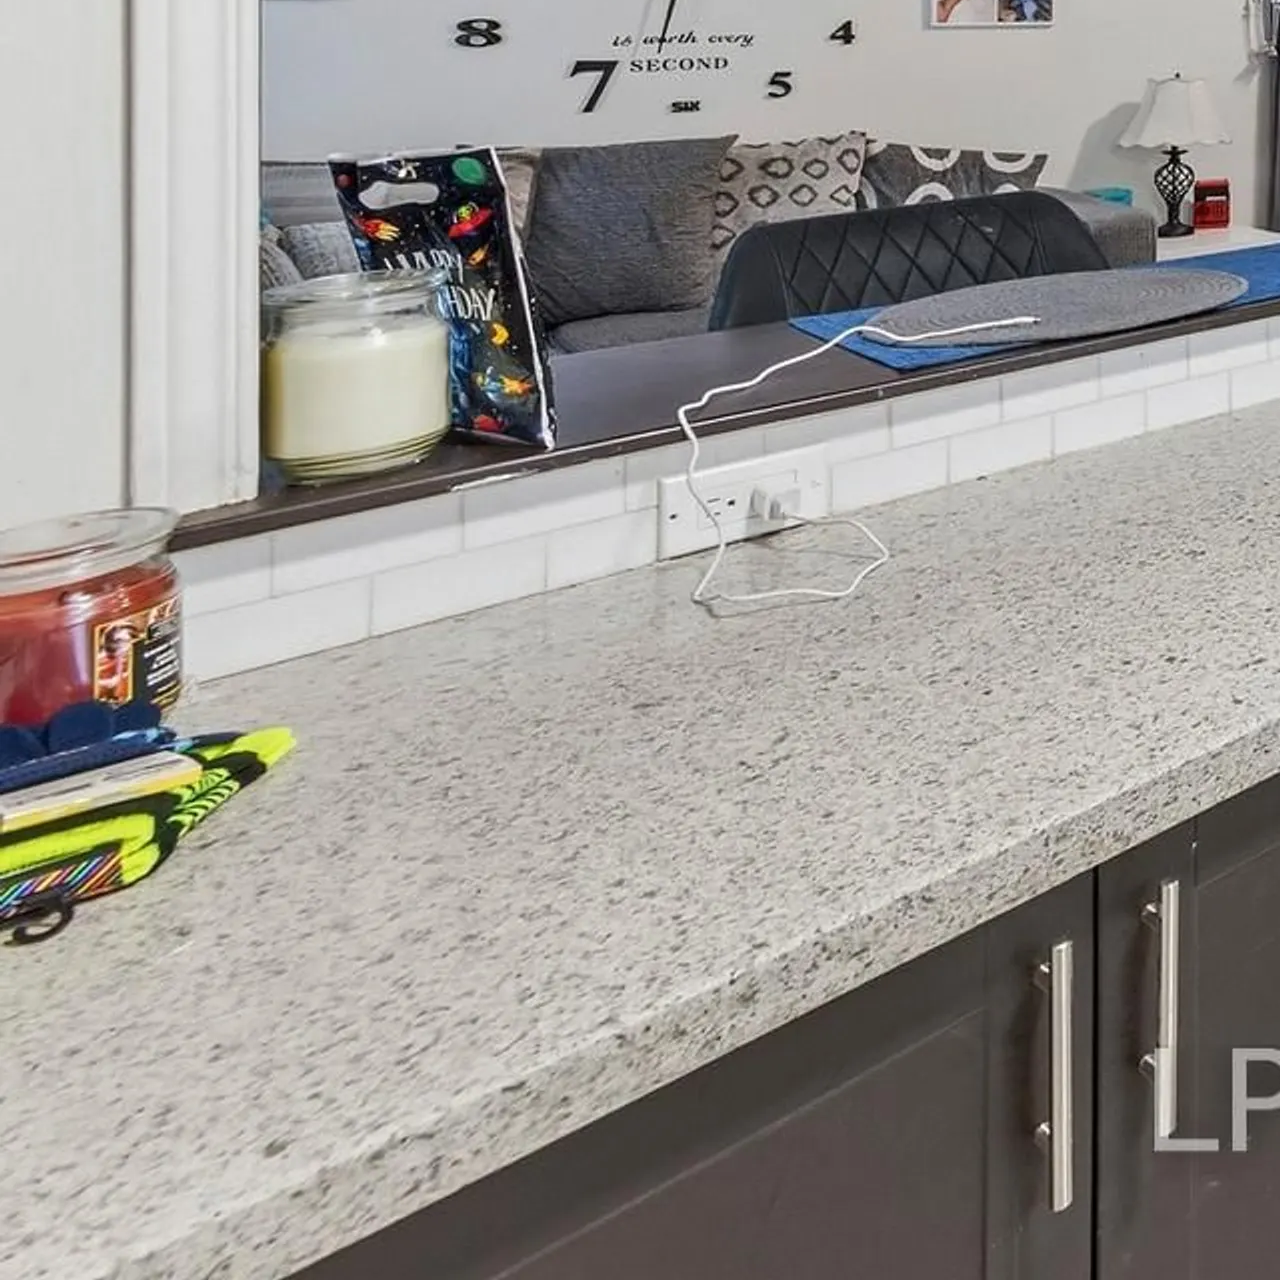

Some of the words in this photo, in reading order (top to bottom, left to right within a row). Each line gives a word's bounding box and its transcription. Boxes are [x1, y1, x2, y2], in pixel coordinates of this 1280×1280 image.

[454, 19, 501, 47] 8
[612, 35, 633, 47] is
[642, 32, 697, 46] worth
[707, 35, 754, 50] every
[830, 21, 854, 45] 4
[629, 57, 728, 73] SECOND
[570, 60, 619, 113] 7
[767, 72, 792, 98] 5
[671, 100, 701, 112] six
